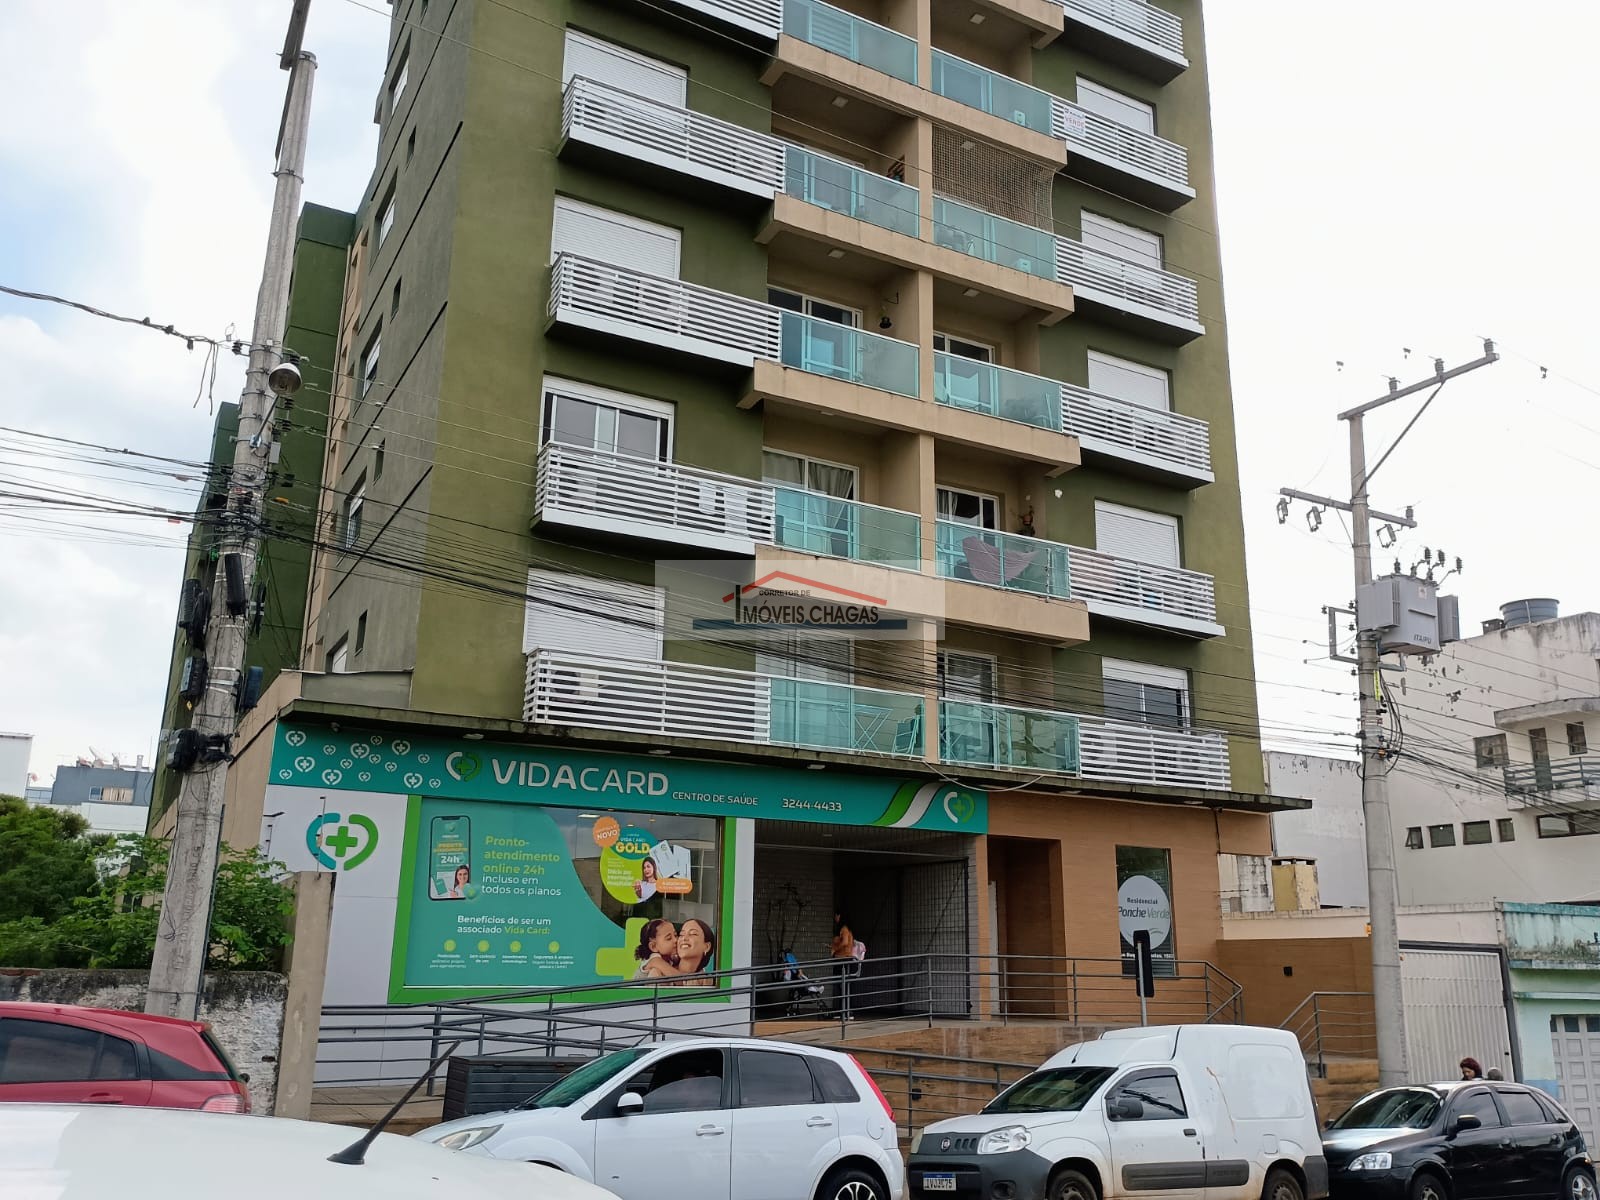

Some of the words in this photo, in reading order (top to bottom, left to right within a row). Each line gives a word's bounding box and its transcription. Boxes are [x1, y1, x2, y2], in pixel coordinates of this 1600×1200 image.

[491, 758, 669, 796] VIDACARD
[672, 791, 711, 802] CENTRO
[712, 794, 725, 803] DE
[727, 792, 759, 806] SAÚDE
[597, 829, 618, 840] NOVO
[485, 835, 529, 846] Pronto-
[615, 842, 651, 854] GOLD
[440, 855, 460, 864] 24h
[484, 850, 560, 862] atendimento
[483, 864, 521, 874] online
[523, 865, 545, 875] 24h
[482, 874, 520, 884] incluso
[482, 885, 511, 894] todos
[513, 887, 525, 895] os
[527, 887, 561, 896] planos
[1127, 897, 1158, 905] Residencial
[1118, 906, 1147, 918] Ponche
[1147, 907, 1170, 920] Verde
[457, 915, 505, 924] Benefícios
[507, 916, 519, 925] de
[457, 925, 502, 934] associado
[504, 926, 524, 934] Vida
